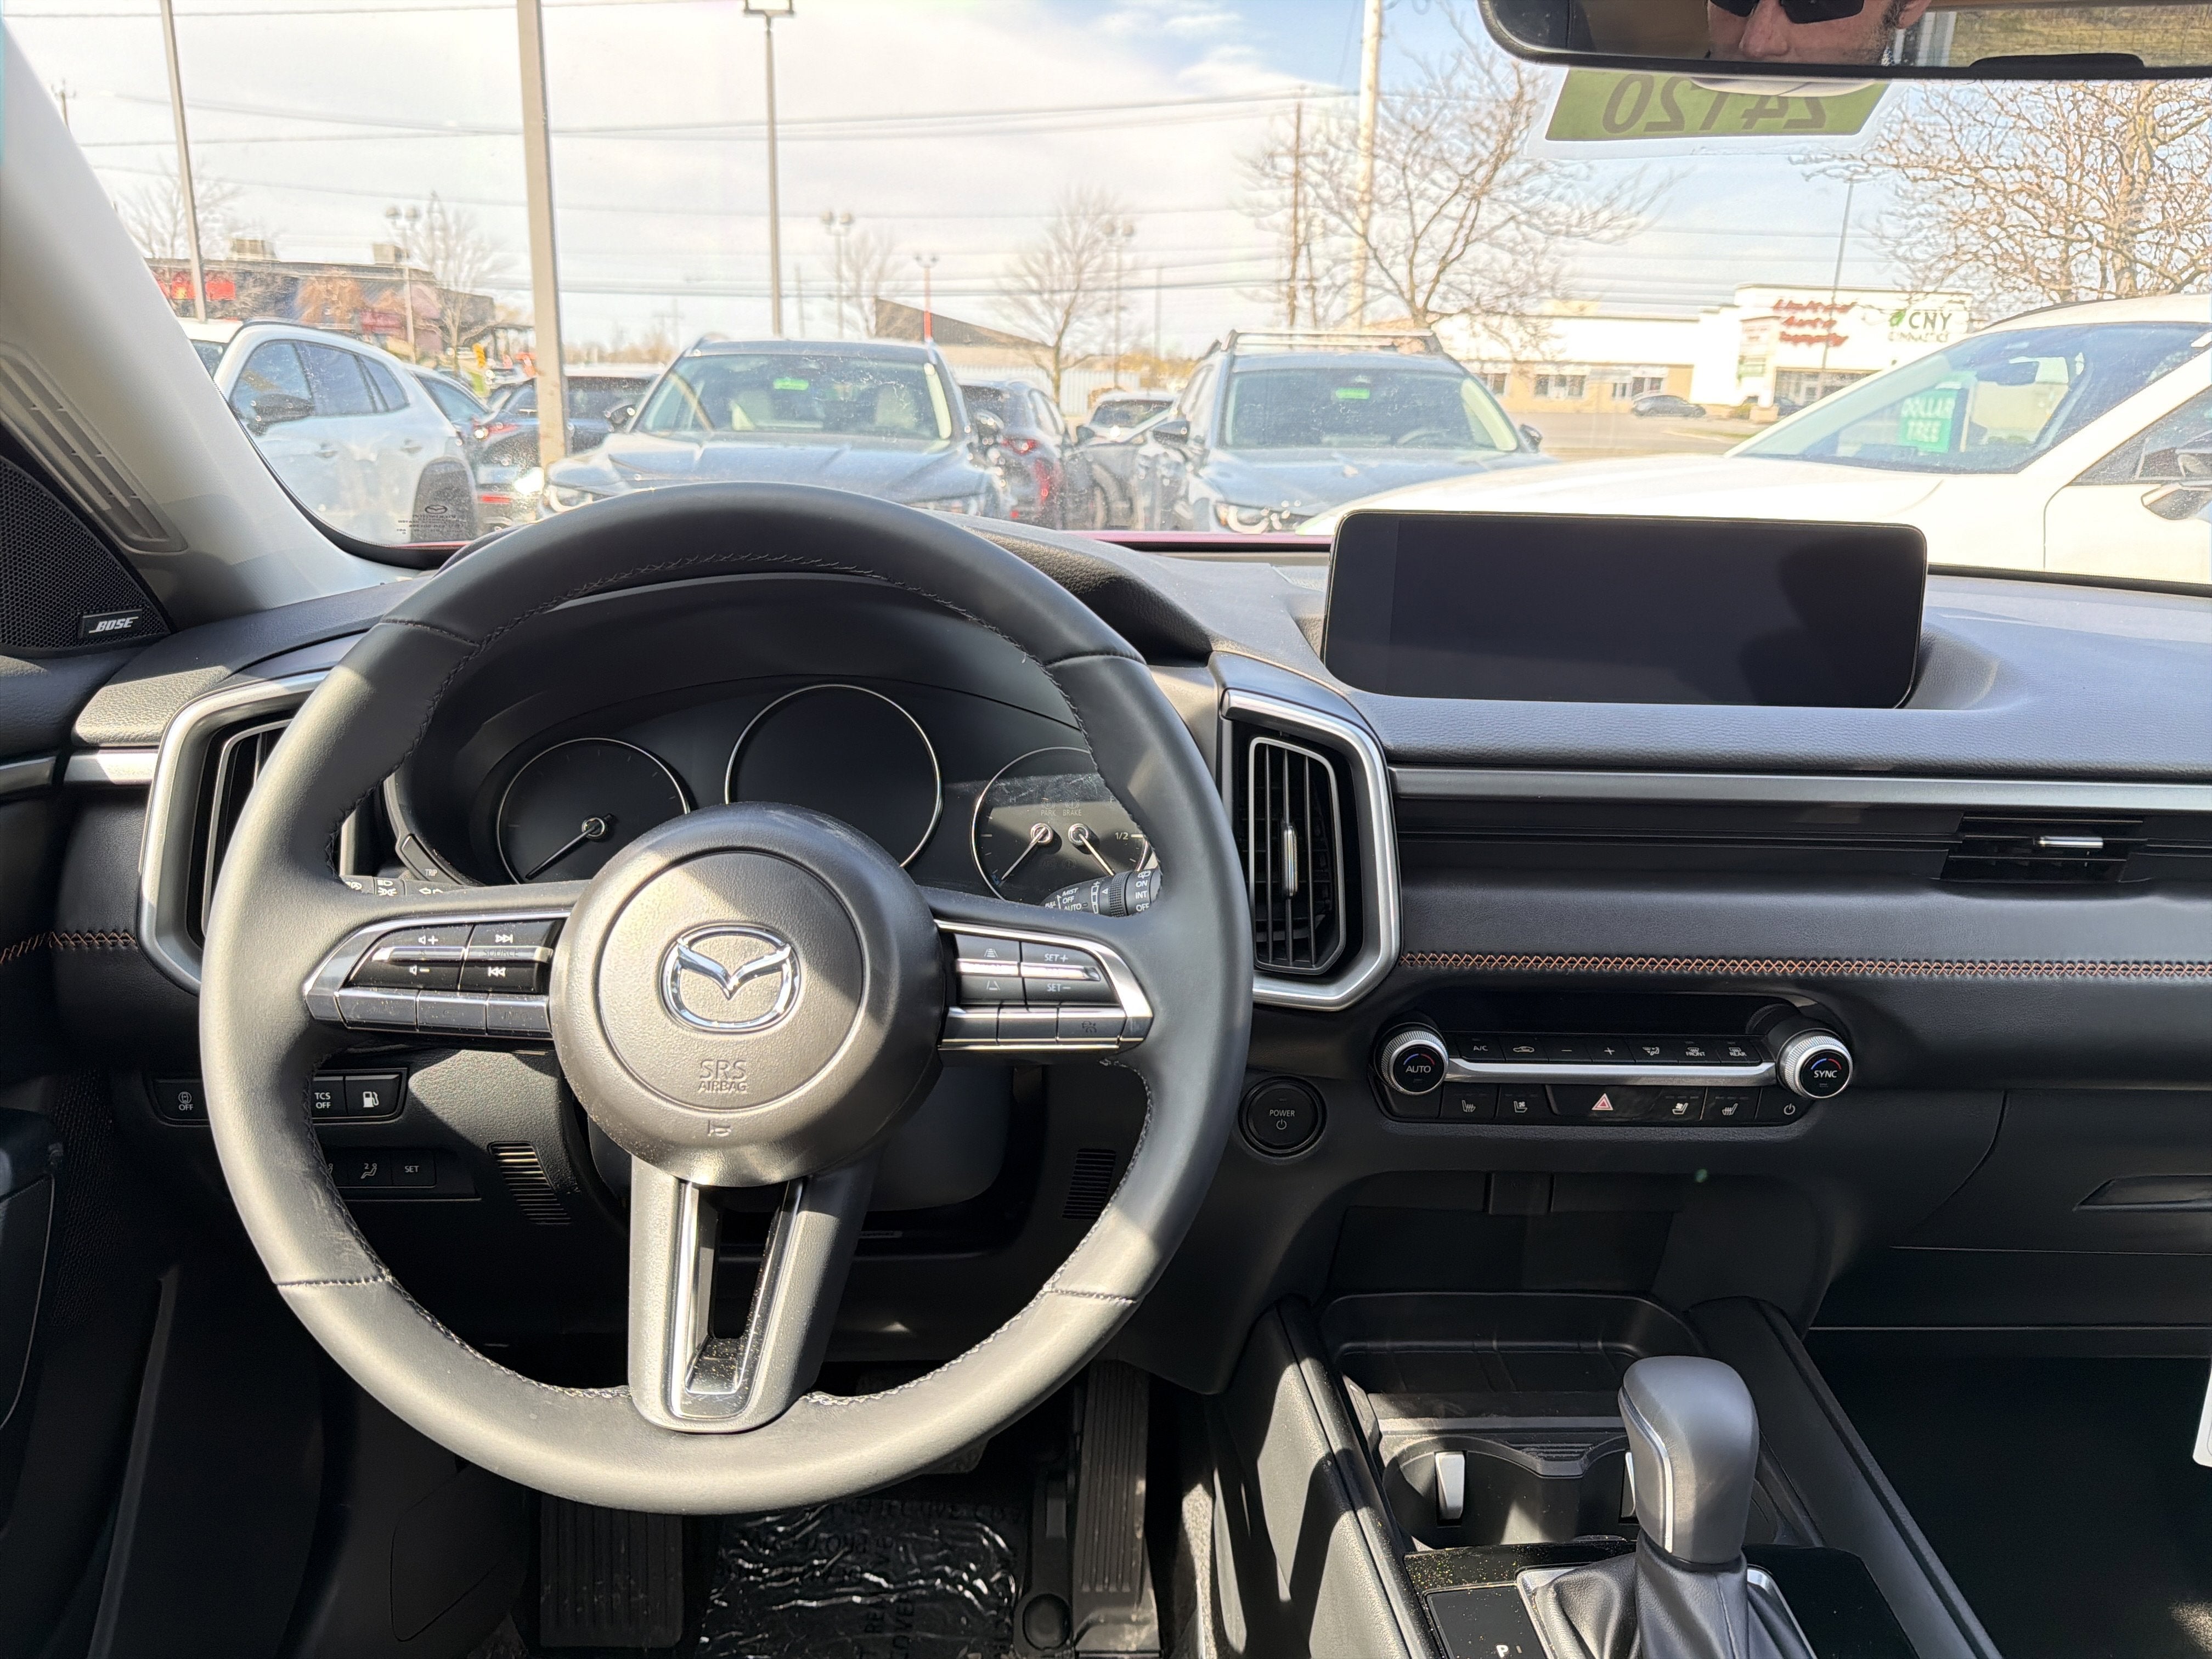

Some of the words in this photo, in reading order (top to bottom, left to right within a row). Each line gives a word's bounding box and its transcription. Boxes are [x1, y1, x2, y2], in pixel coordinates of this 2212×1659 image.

[1909, 312, 1952, 330] CNY
[88, 616, 139, 634] BOSE
[1115, 832, 1128, 840] 1/2
[425, 868, 437, 877] TRIP
[1062, 887, 1079, 897] MIST
[1135, 890, 1148, 899] INT
[1062, 896, 1075, 904] OFF
[1064, 903, 1082, 911] AUTO
[1136, 902, 1149, 912] OFF
[699, 1059, 747, 1080] SRS
[1406, 1065, 1431, 1074] AUTO
[1814, 1070, 1838, 1079] SYNC
[698, 1080, 748, 1093] AIRBAG
[314, 1092, 331, 1100] TCS
[1269, 1109, 1295, 1118] POWER
[1496, 1645, 1509, 1657] P
